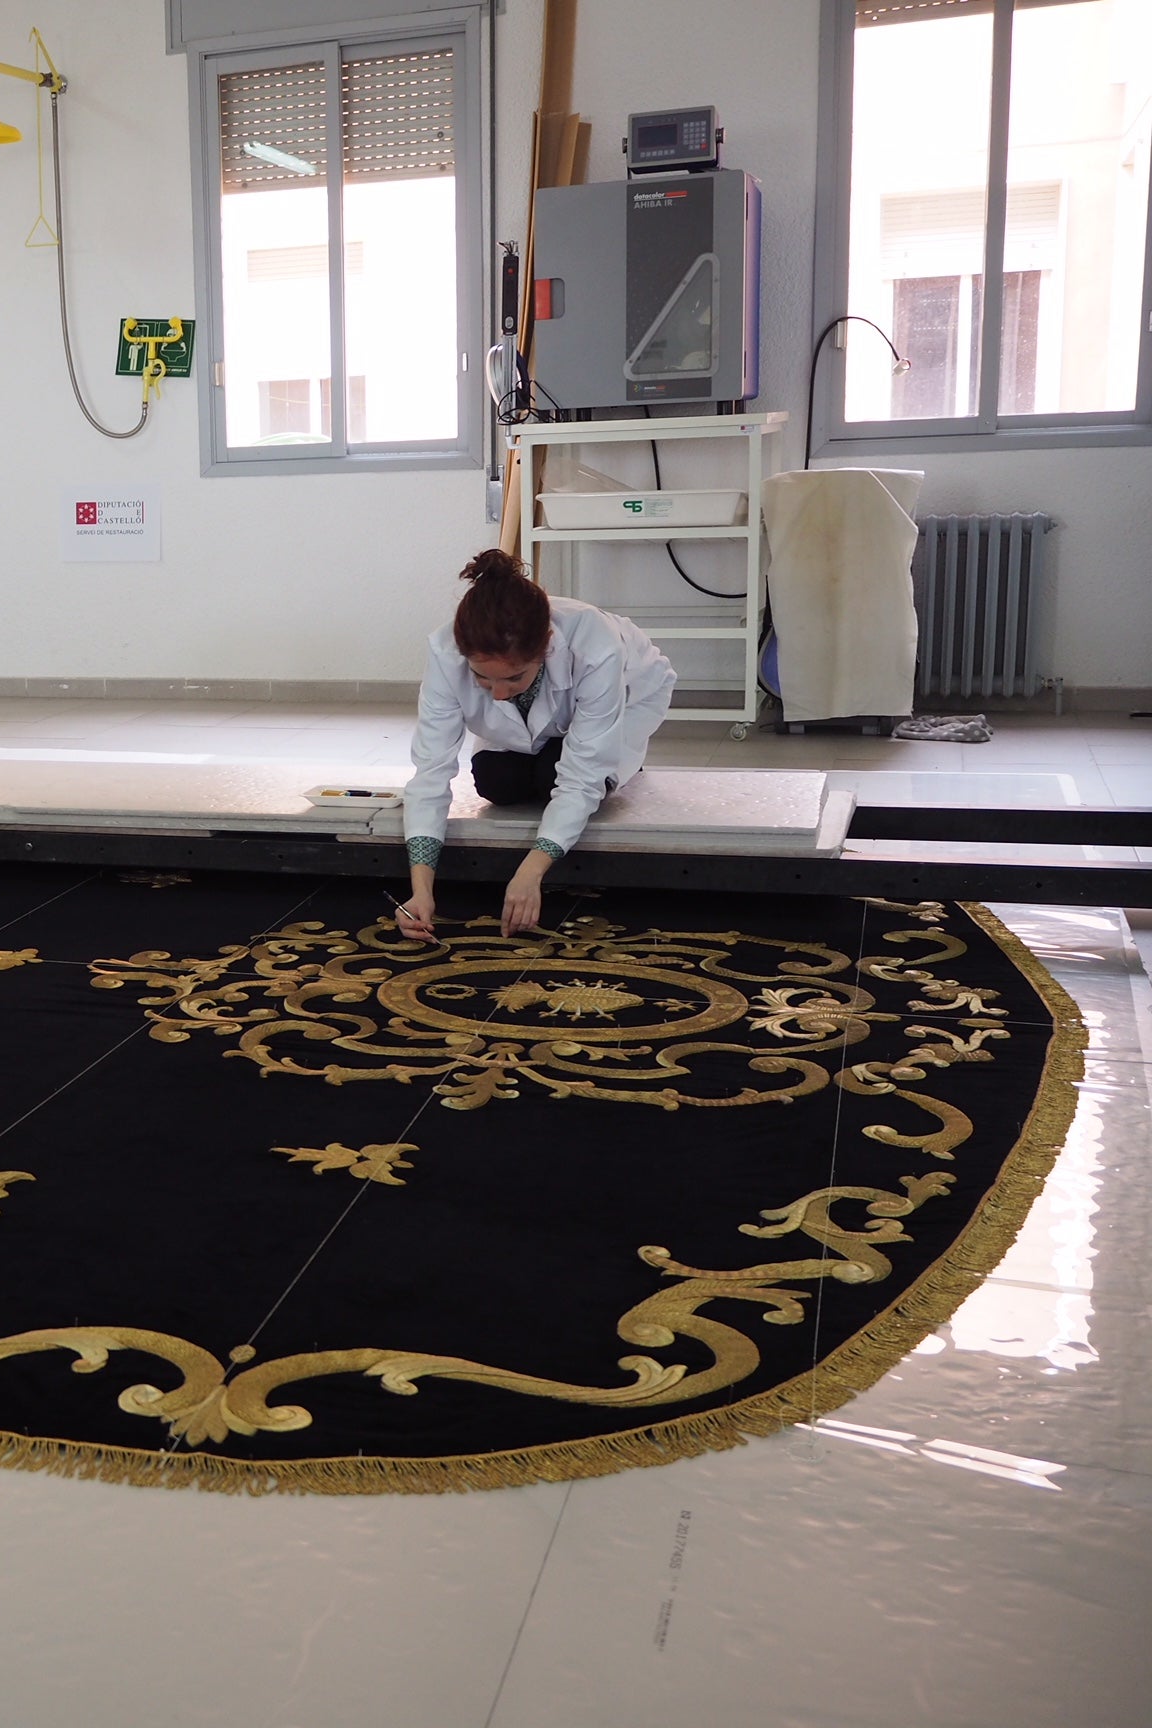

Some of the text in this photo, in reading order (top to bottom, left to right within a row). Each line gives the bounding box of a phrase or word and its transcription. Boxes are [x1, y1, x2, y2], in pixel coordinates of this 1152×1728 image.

[633, 191, 665, 200] datacolor
[634, 199, 673, 209] AHIBA IR
[97, 500, 141, 508] DIPUTACIÓ
[97, 517, 142, 525] CASTELLÓ
